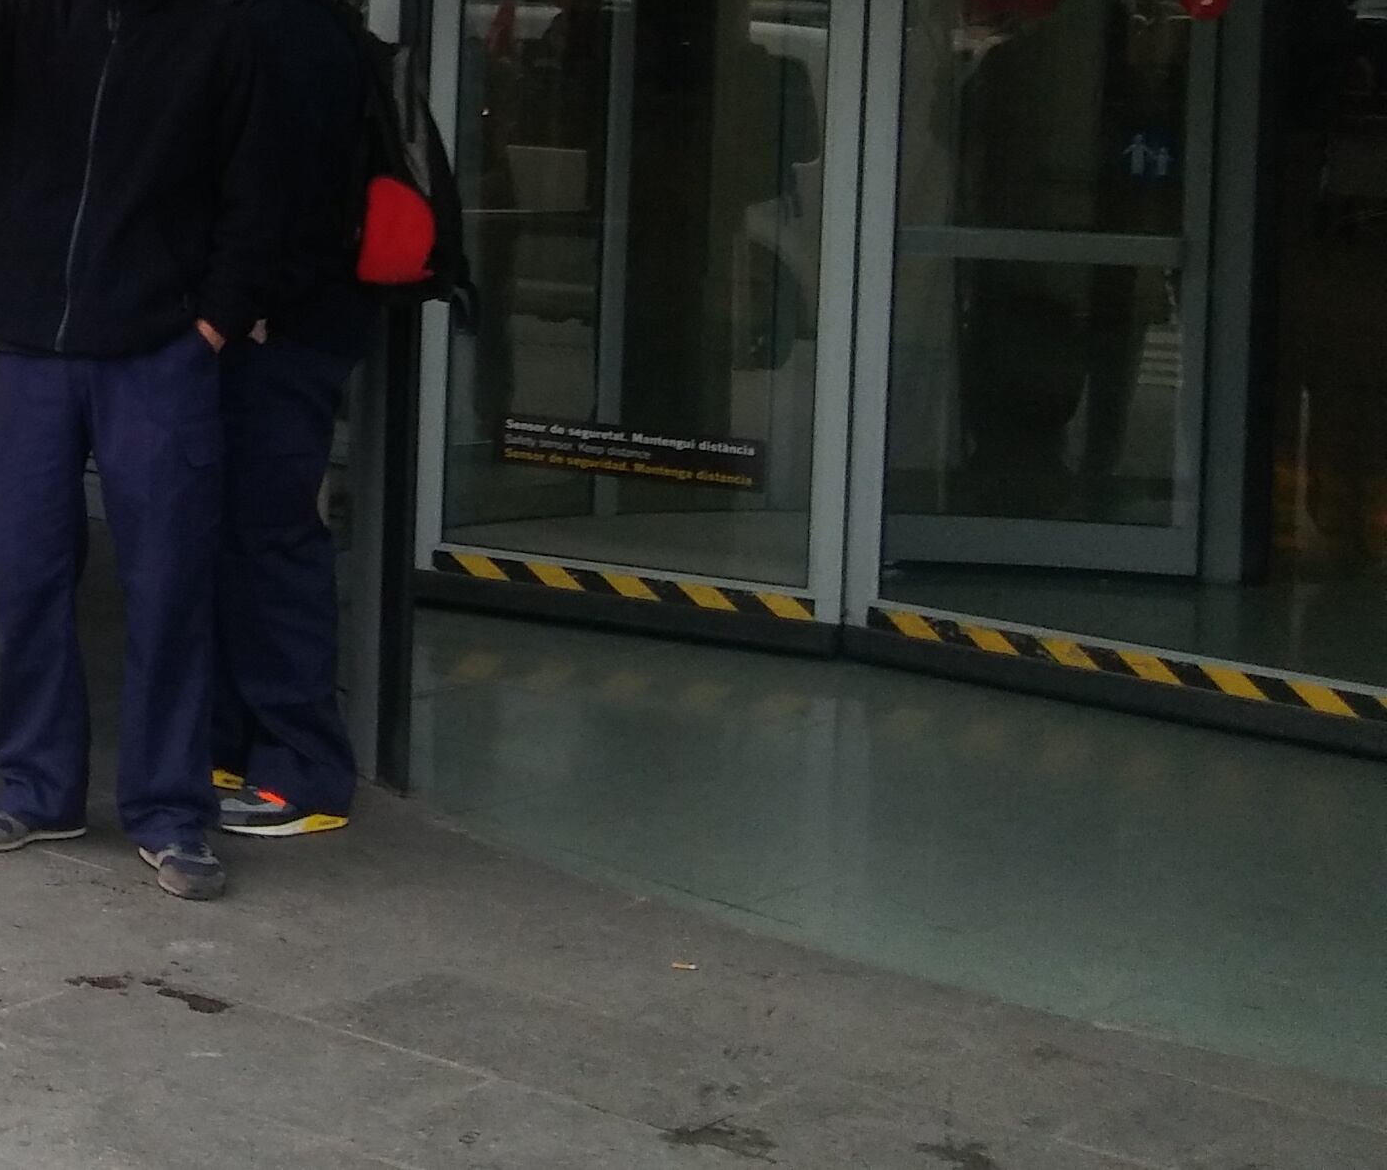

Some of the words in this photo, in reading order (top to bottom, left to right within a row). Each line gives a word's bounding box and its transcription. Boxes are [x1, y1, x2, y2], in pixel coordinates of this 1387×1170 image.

[504, 418, 547, 434] Sensor
[549, 424, 565, 435] de
[548, 453, 564, 464] de
